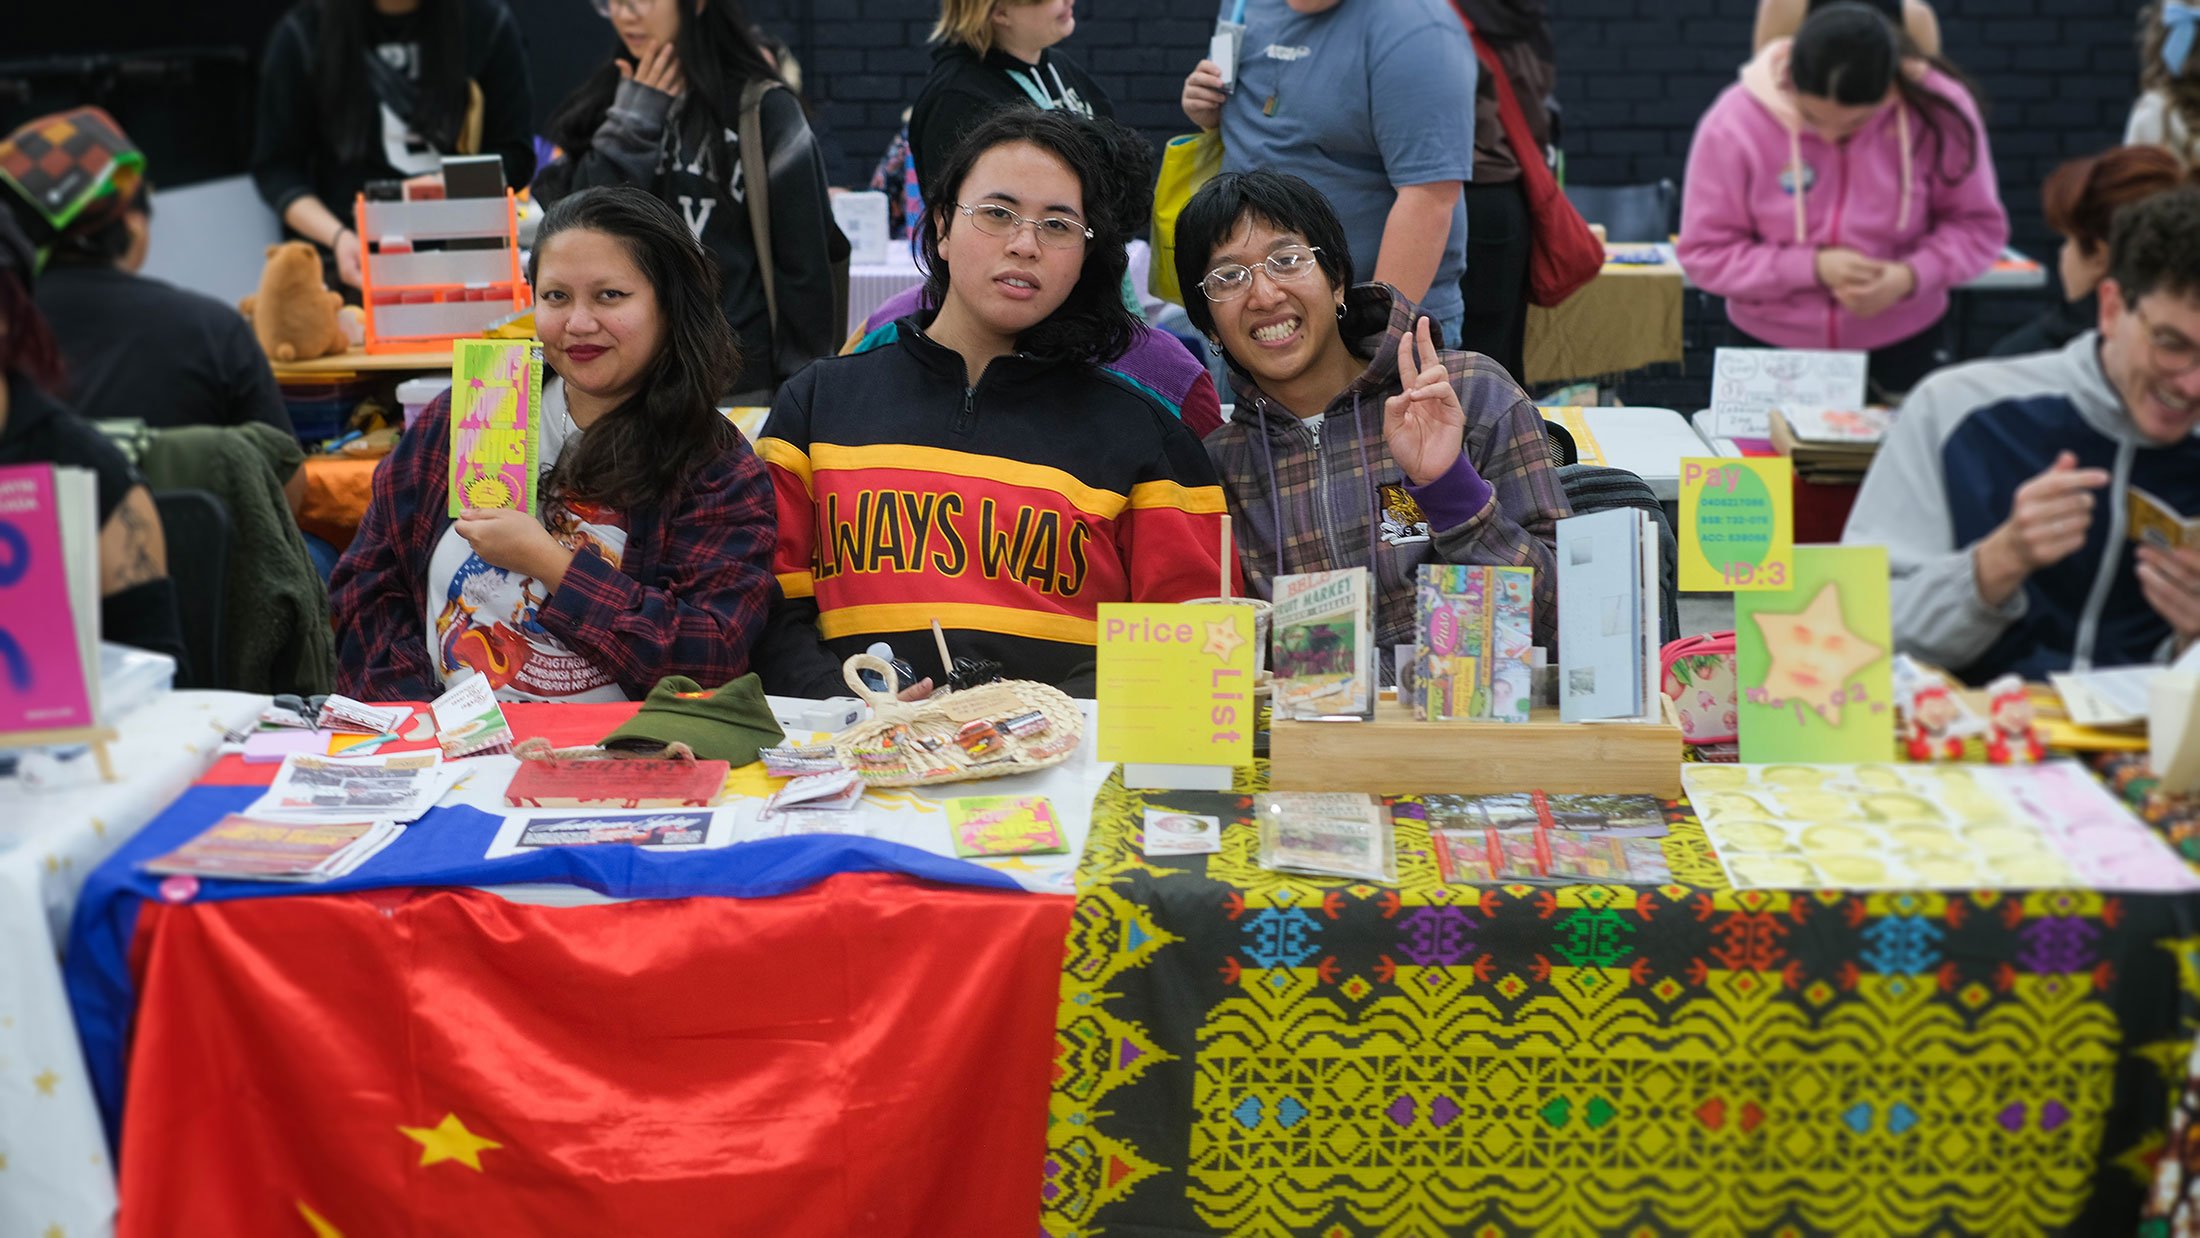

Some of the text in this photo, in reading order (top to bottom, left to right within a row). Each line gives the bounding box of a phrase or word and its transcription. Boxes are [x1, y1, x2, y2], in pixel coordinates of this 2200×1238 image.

[1685, 463, 1740, 493] Pay
[979, 498, 1091, 598] WAS
[1304, 576, 1353, 606] MARKET
[1106, 617, 1193, 644] Price
[1211, 669, 1244, 743] List
